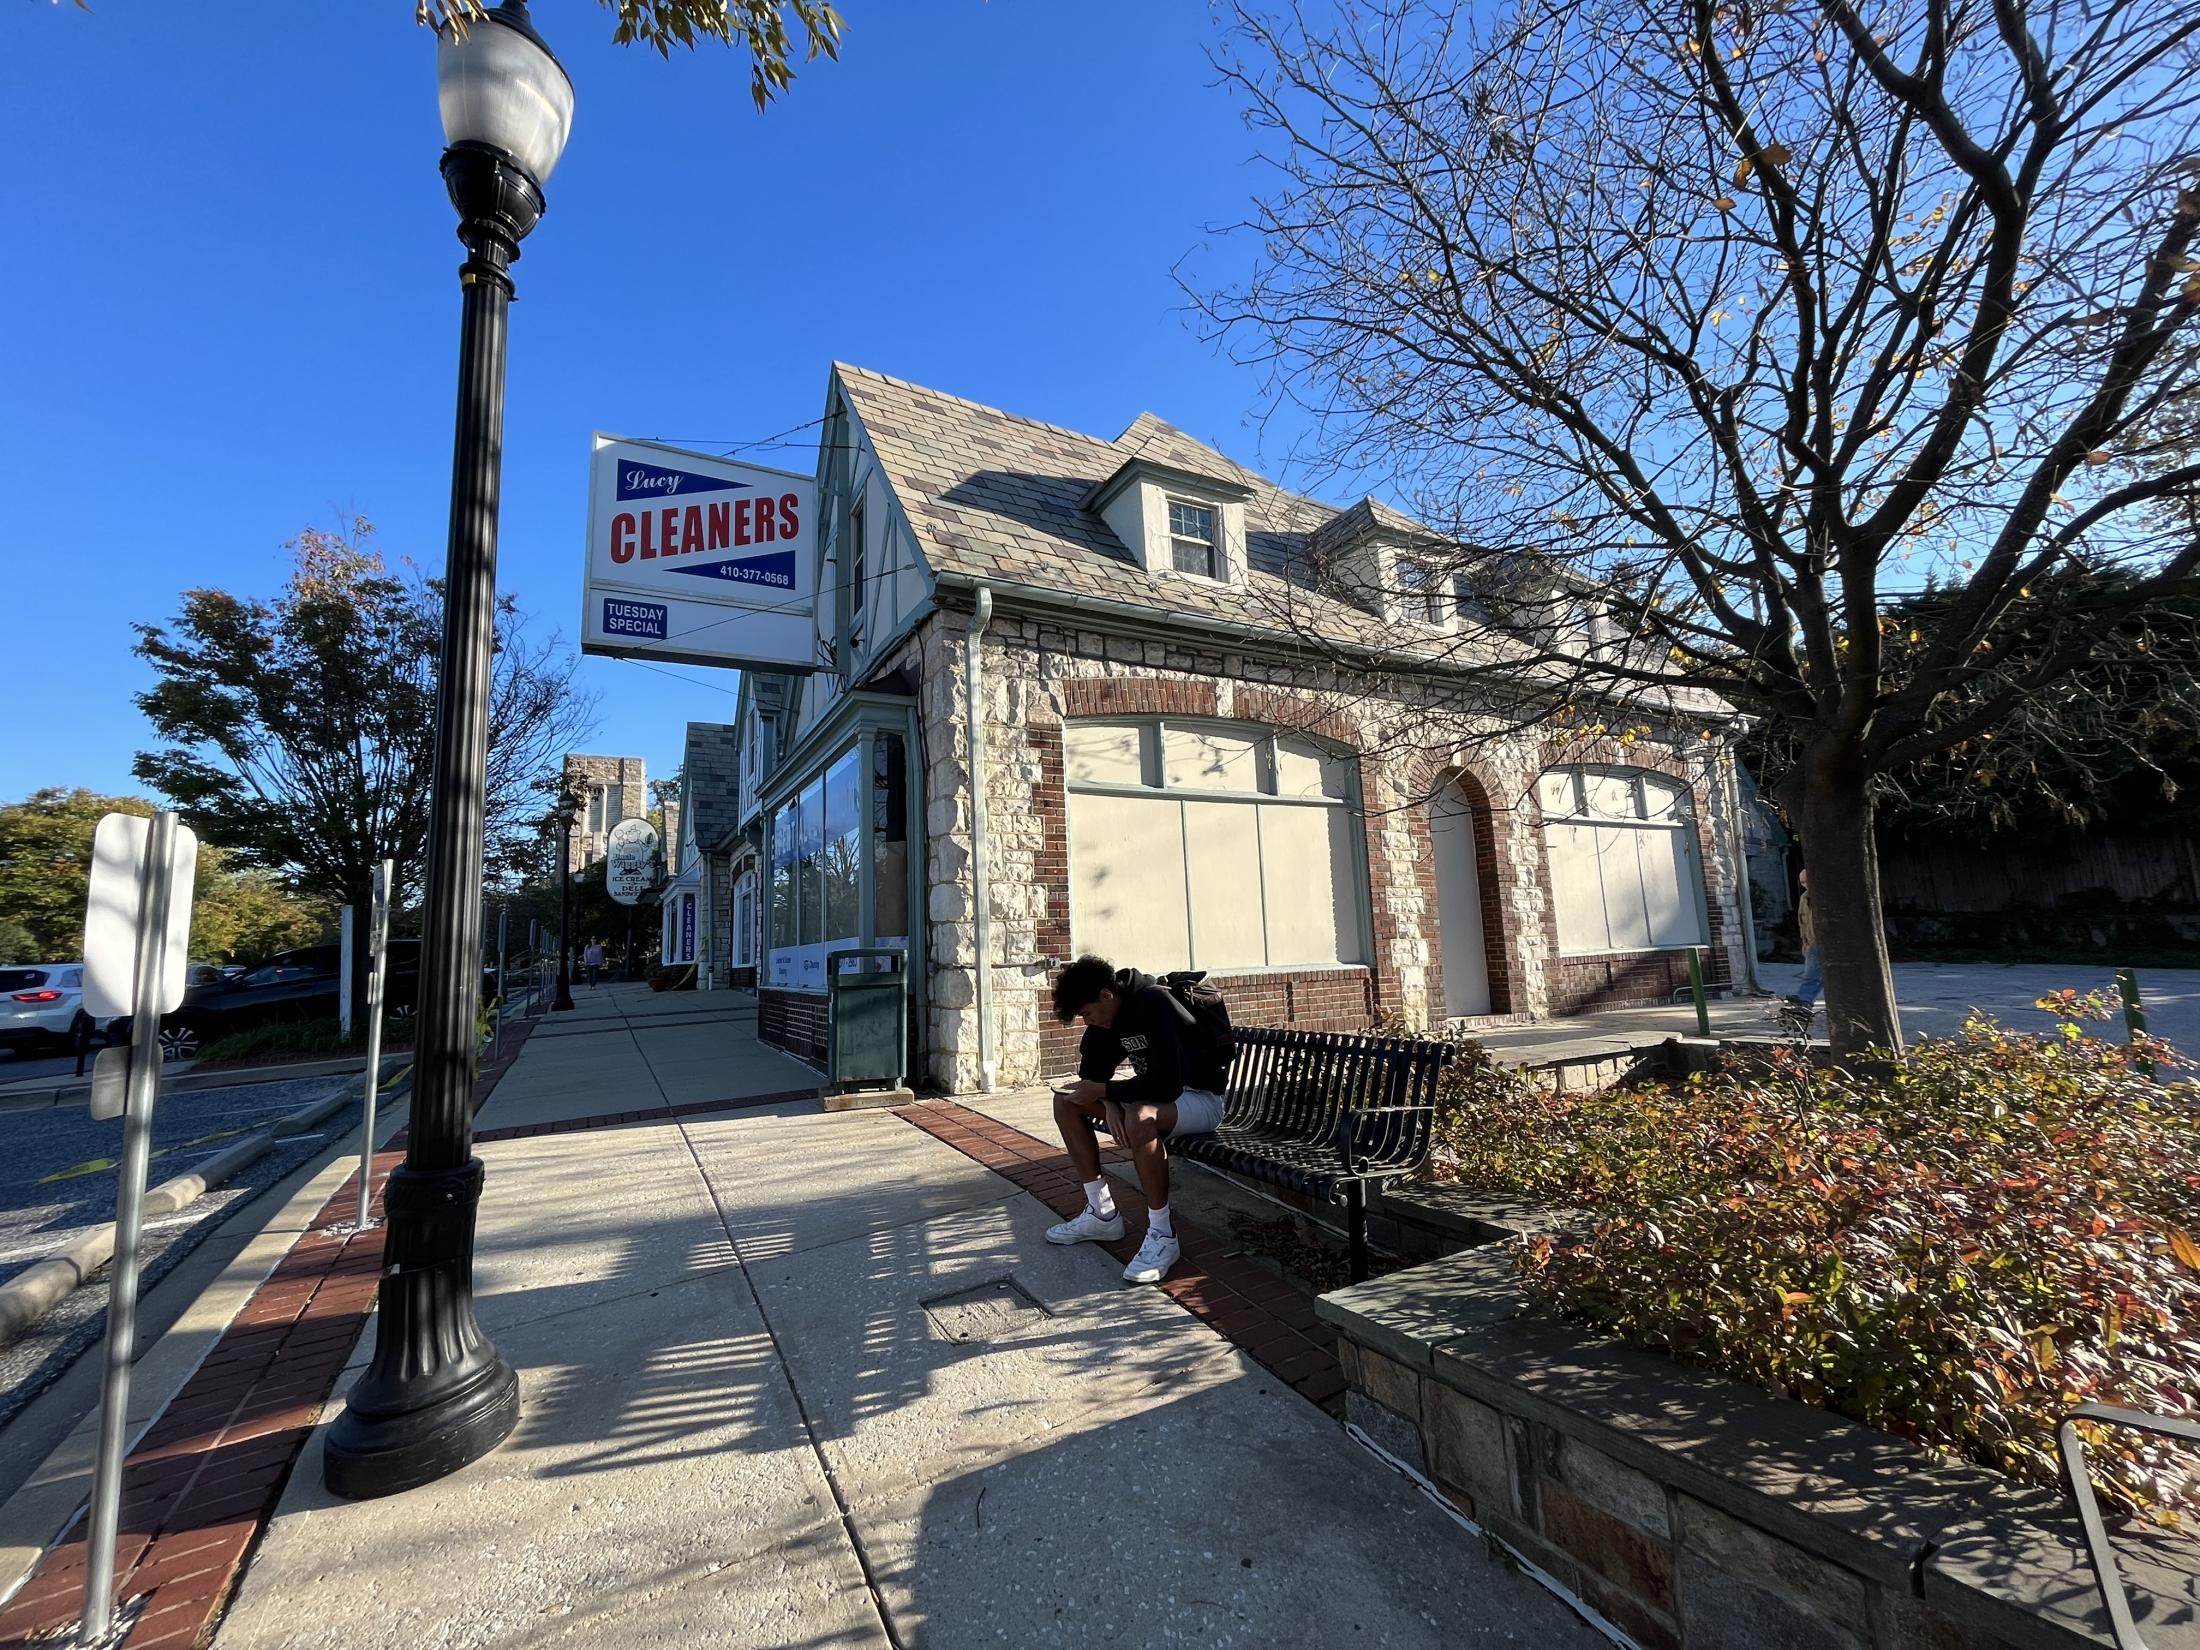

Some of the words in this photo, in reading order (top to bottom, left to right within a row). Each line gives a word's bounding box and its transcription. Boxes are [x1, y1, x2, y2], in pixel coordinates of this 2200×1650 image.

[625, 470, 685, 495] Lucy
[610, 493, 800, 564] CLEANERS
[720, 565, 789, 586] 410-377-0568
[607, 603, 664, 621] TUESDAY
[608, 617, 661, 635] SPECIAL
[685, 902, 693, 960] CLEANERS
[1119, 1034, 1149, 1053] SON
